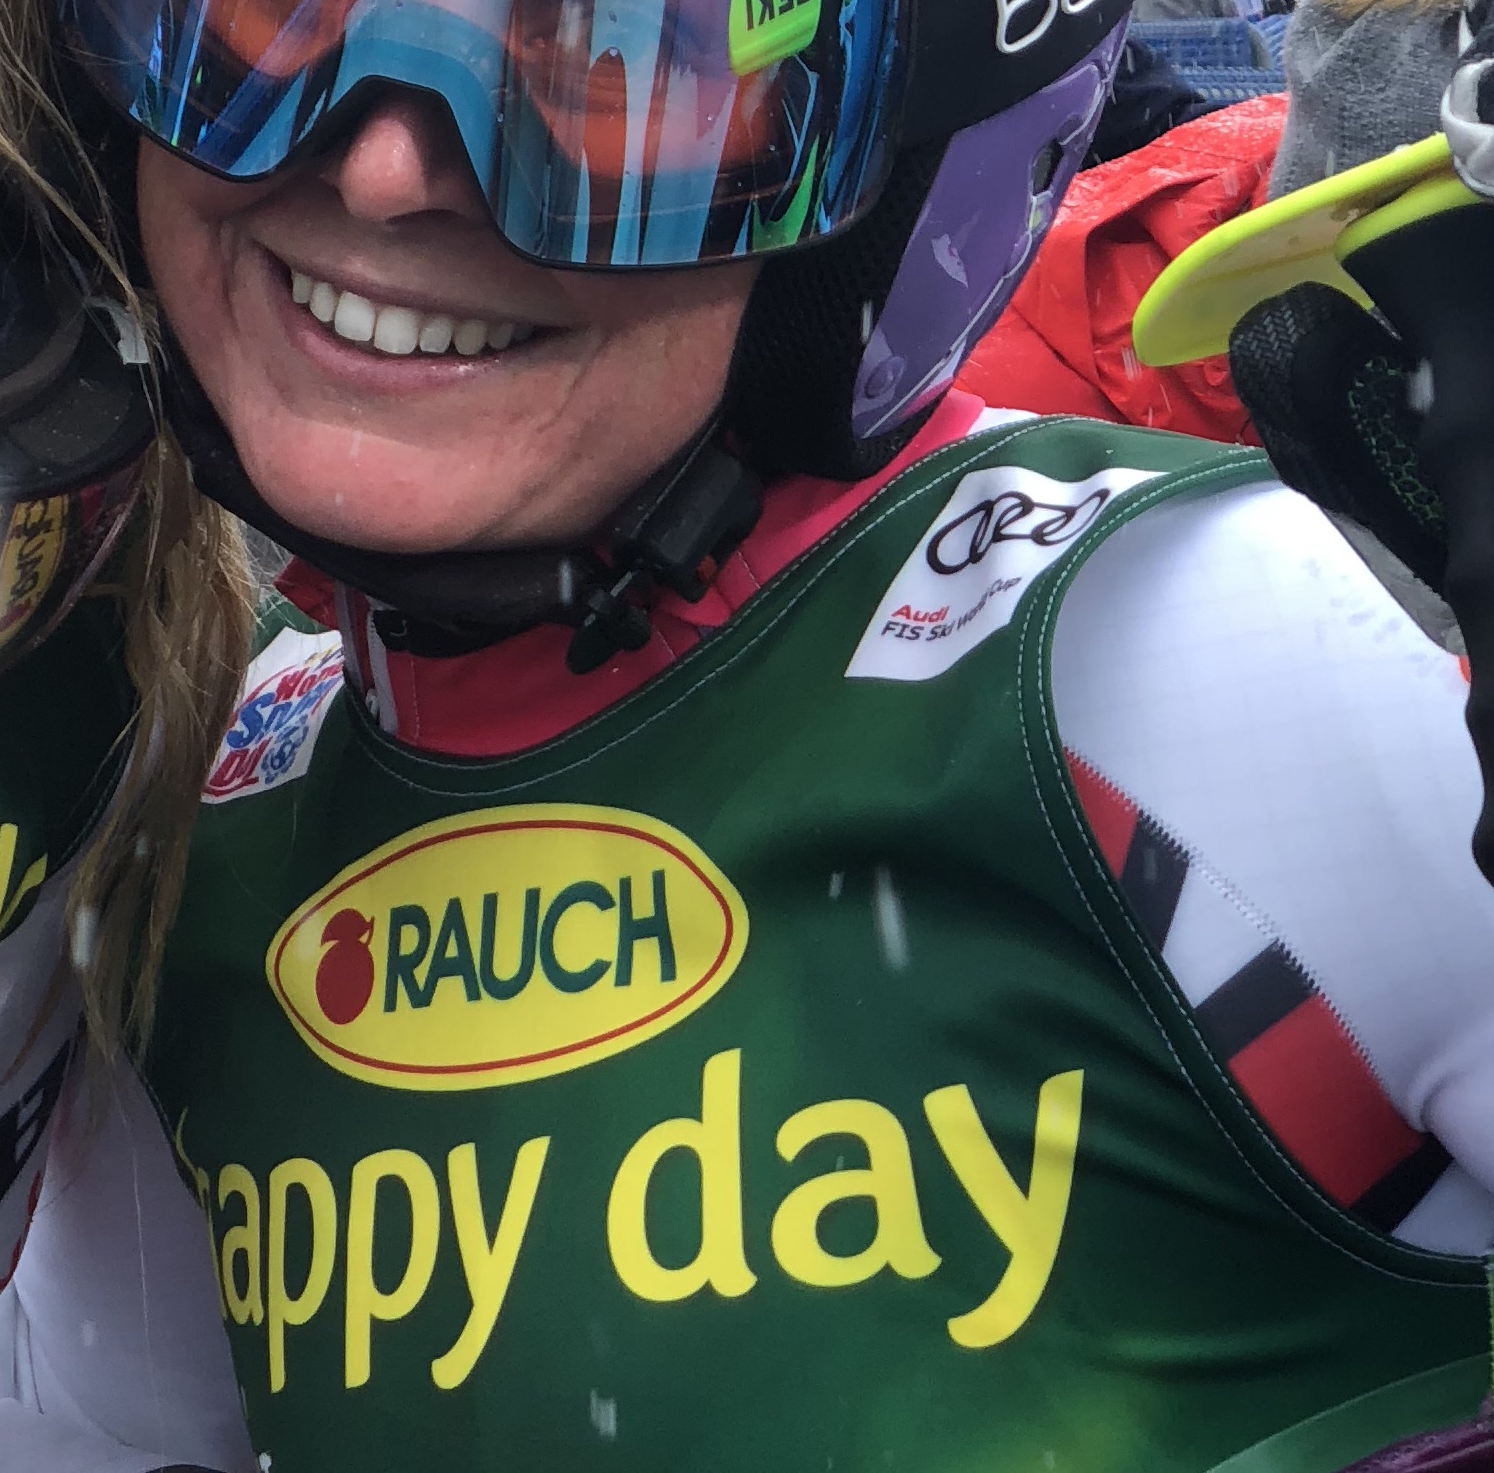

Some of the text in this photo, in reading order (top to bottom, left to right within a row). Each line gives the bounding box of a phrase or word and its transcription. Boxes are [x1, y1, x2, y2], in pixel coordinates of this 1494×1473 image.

[880, 620, 926, 641] FIS
[890, 603, 951, 624] Audi
[382, 869, 678, 1014] RAUCH
[606, 1047, 1086, 1350] day
